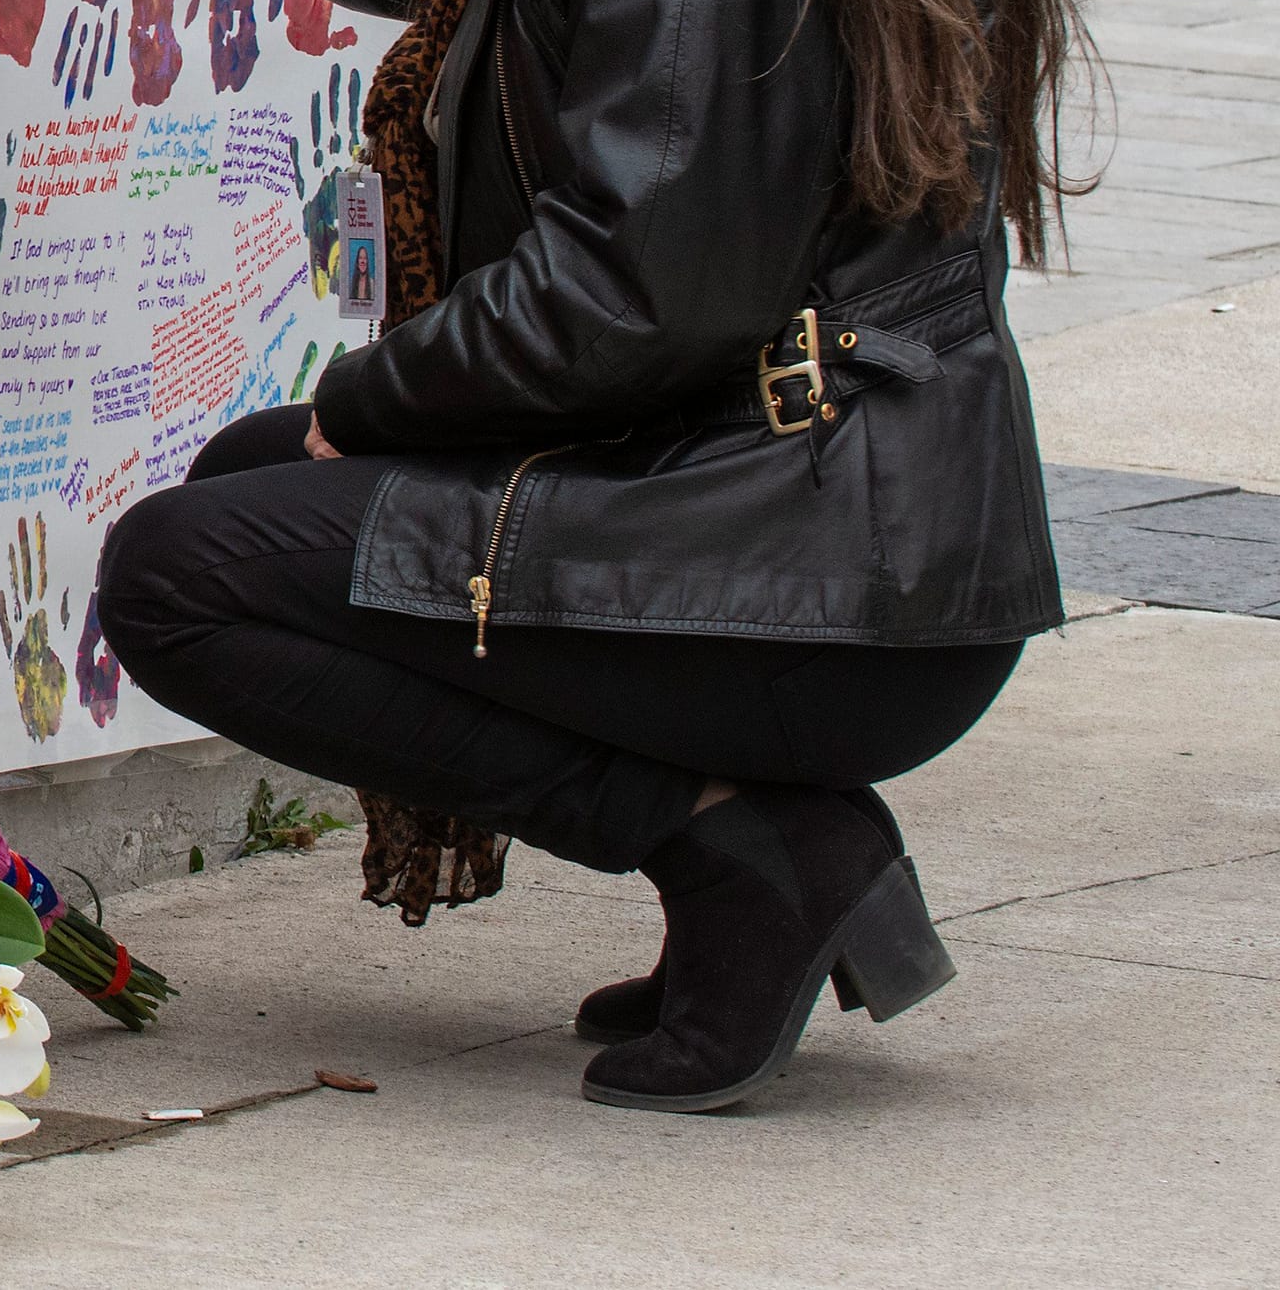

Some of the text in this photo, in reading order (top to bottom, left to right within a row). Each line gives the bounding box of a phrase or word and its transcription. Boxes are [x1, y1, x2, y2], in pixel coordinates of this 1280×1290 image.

[10, 238, 22, 261] If
[48, 237, 75, 264] brings
[79, 237, 97, 263] you
[103, 232, 112, 250] to
[24, 273, 50, 299] bring
[52, 274, 69, 300] you
